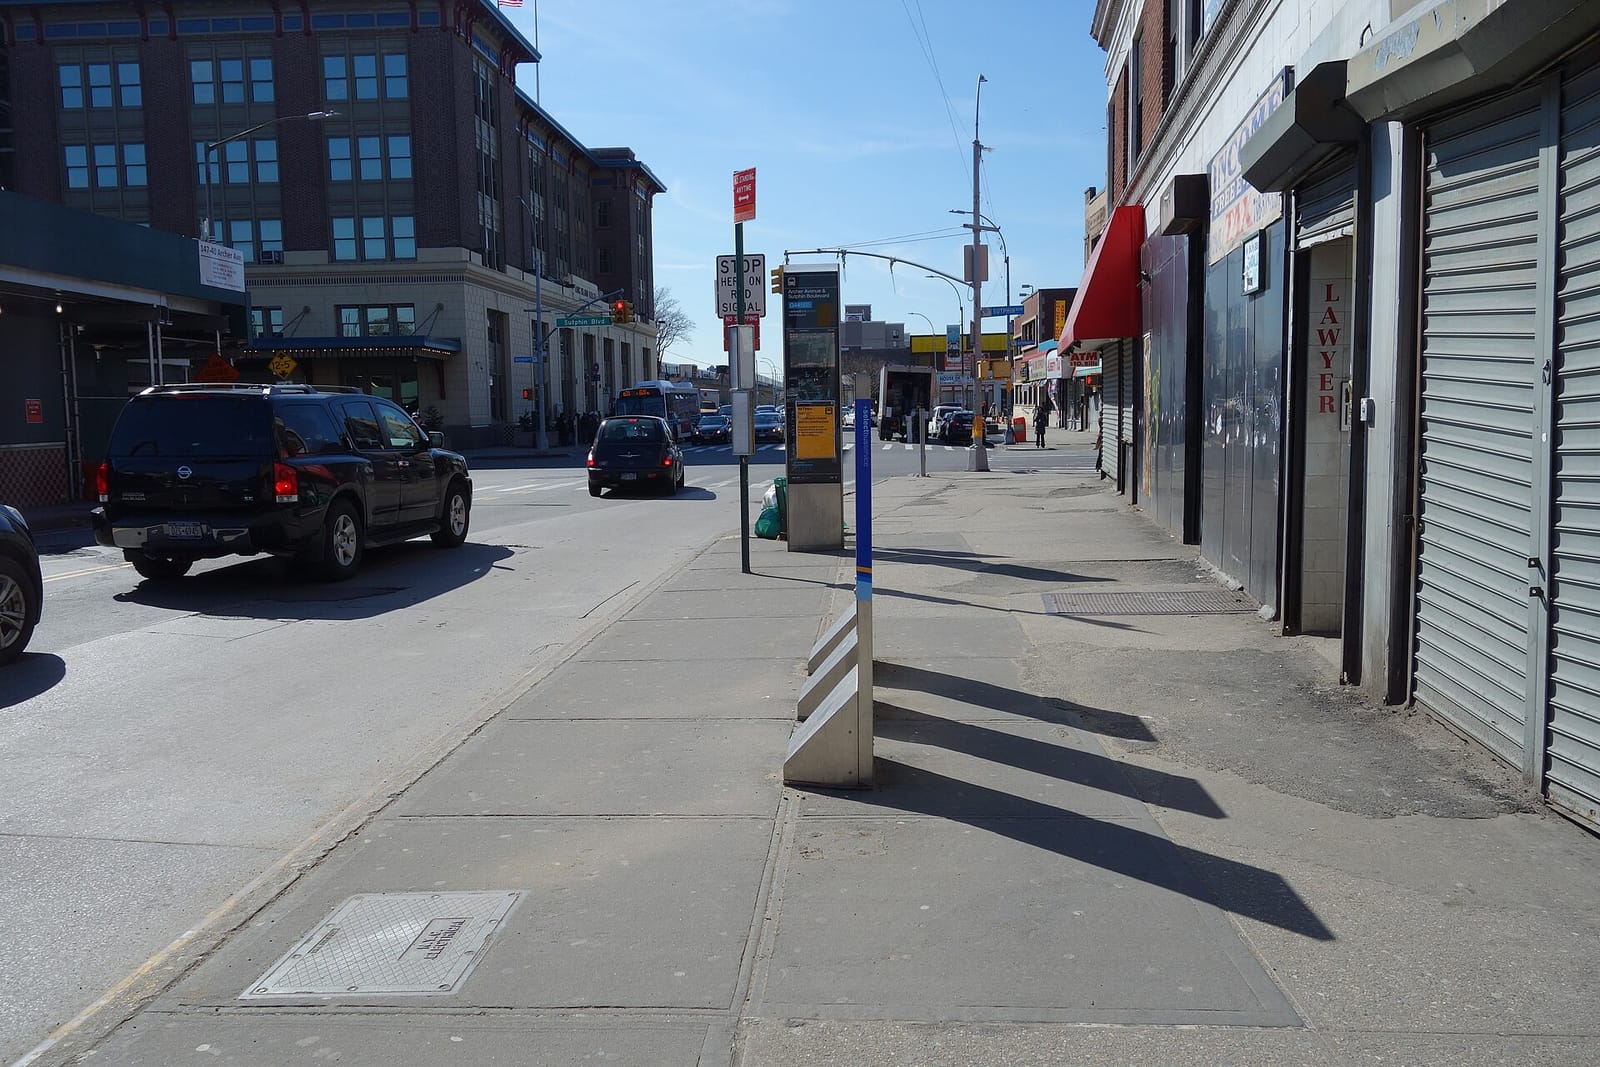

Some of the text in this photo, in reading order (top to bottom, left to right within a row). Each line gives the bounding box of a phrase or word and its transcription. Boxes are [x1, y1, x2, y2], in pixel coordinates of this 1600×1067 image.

[1225, 195, 1253, 243] TAX
[720, 259, 761, 274] STOP
[721, 276, 761, 287] HER ON
[731, 289, 752, 299] RD
[722, 301, 761, 312] SIGAL
[734, 314, 759, 322] SPPING
[1317, 284, 1340, 413] LAWYER
[1071, 351, 1098, 361] ATM
